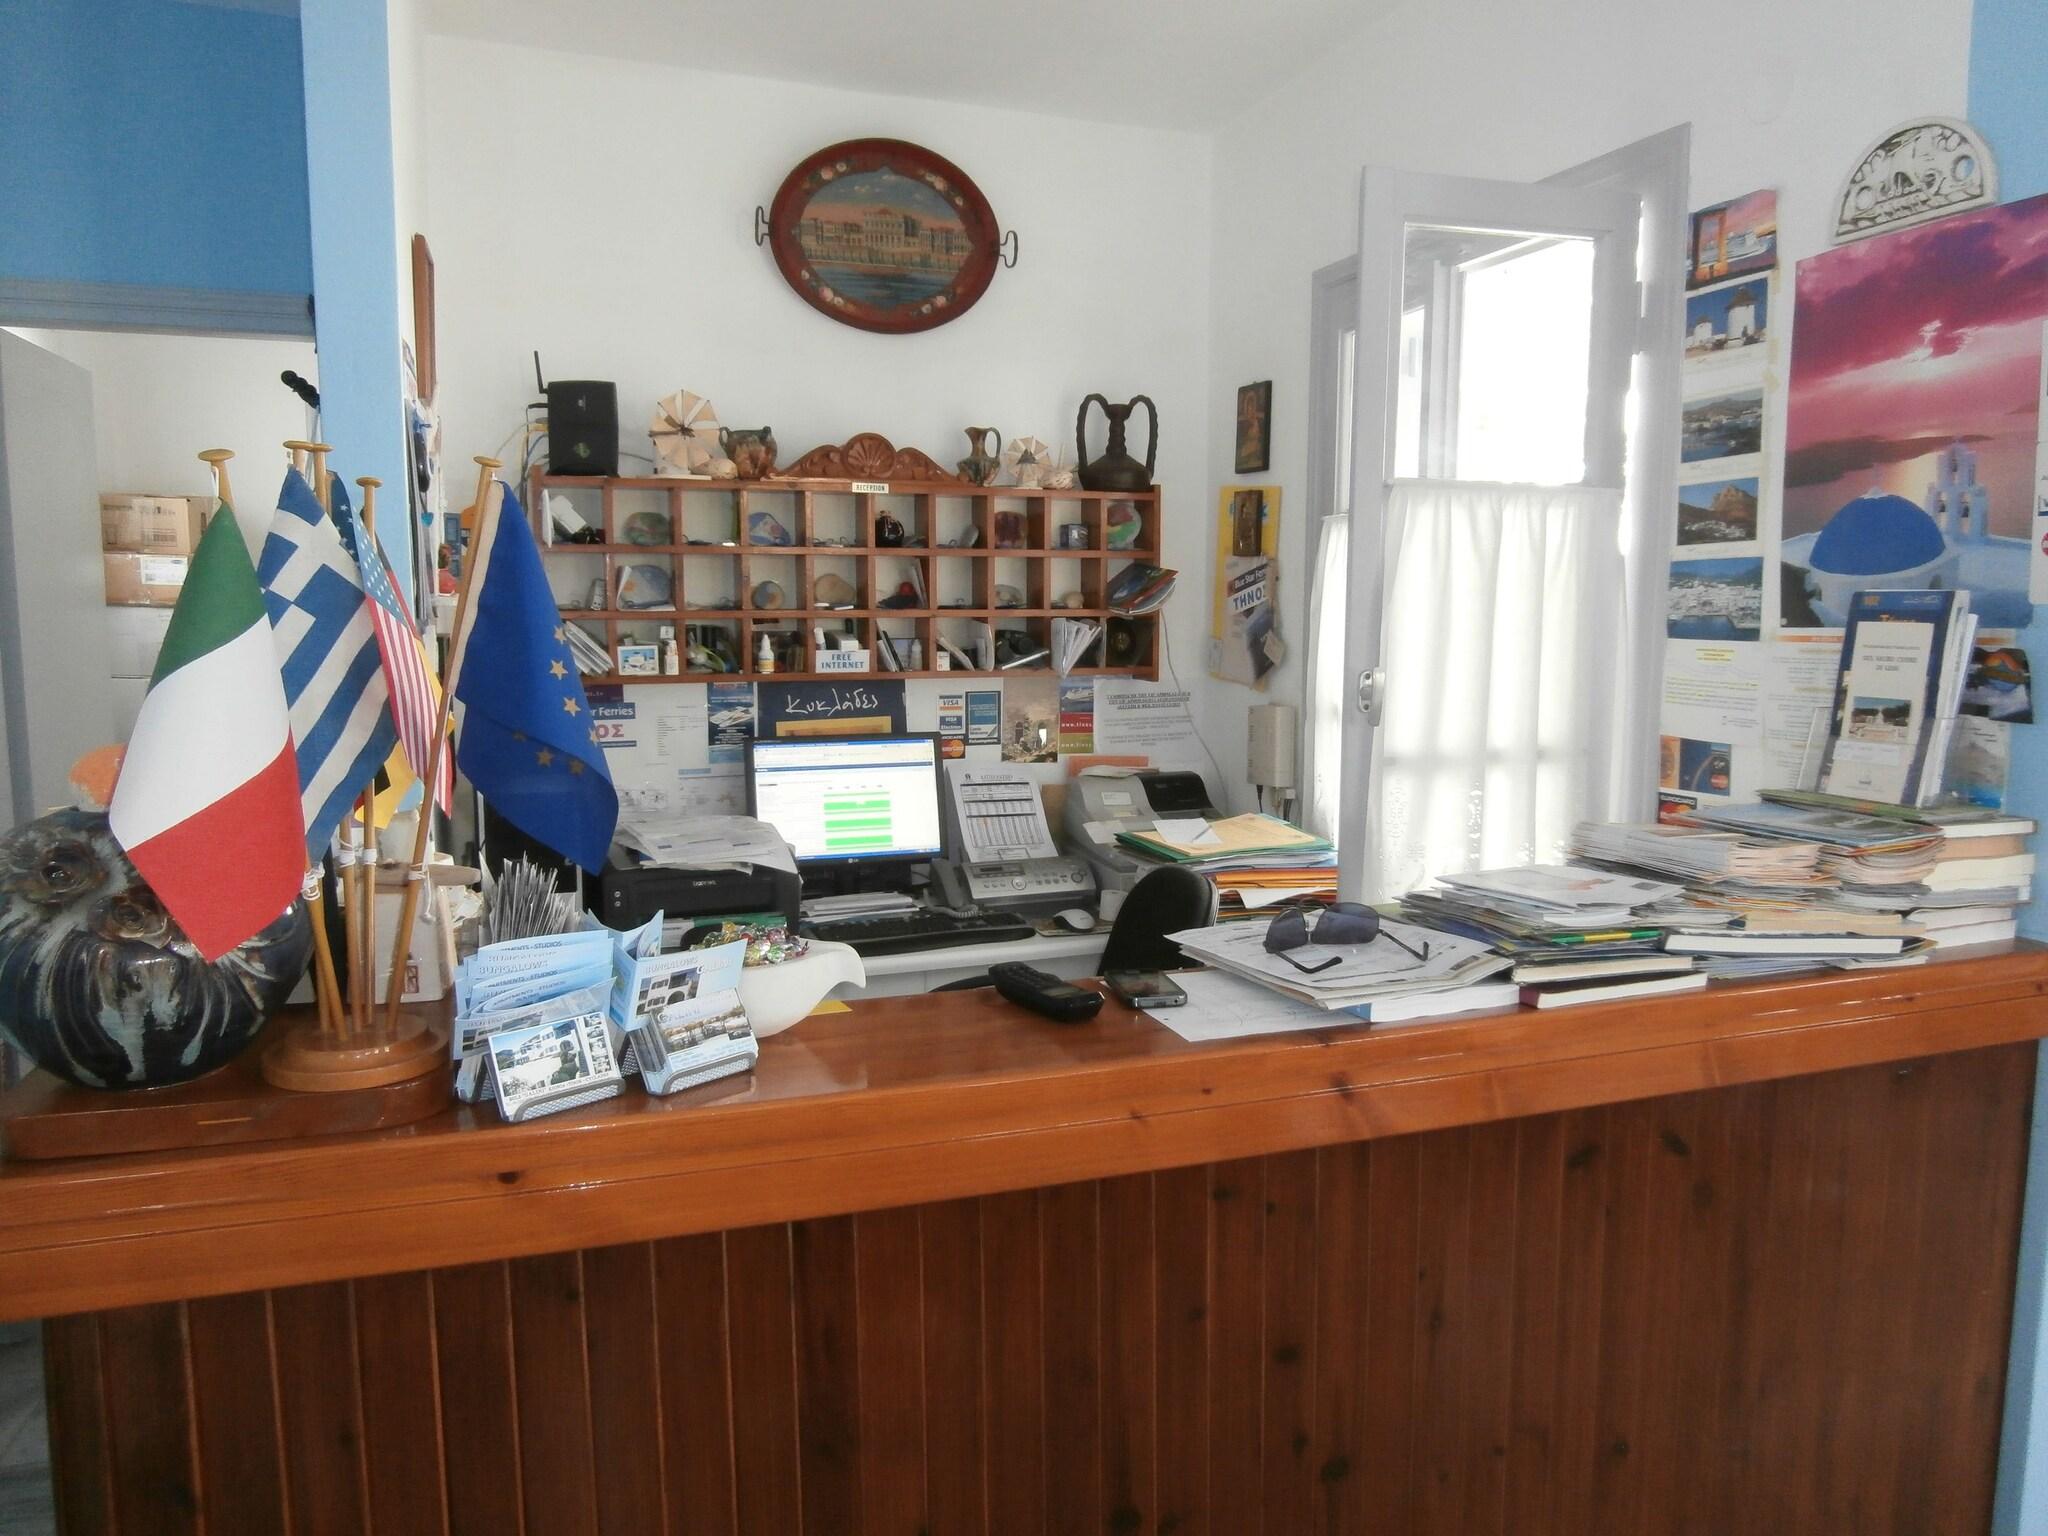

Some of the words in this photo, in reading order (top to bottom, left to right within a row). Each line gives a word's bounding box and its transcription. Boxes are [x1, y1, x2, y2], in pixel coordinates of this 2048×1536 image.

[855, 484, 885, 492] RECEPTION
[1233, 585, 1265, 610] ΤΗΝΟ
[831, 653, 852, 661] FREE
[821, 661, 865, 669] INTERNET
[599, 706, 634, 717] Ferries
[595, 724, 625, 738] ΟΣ
